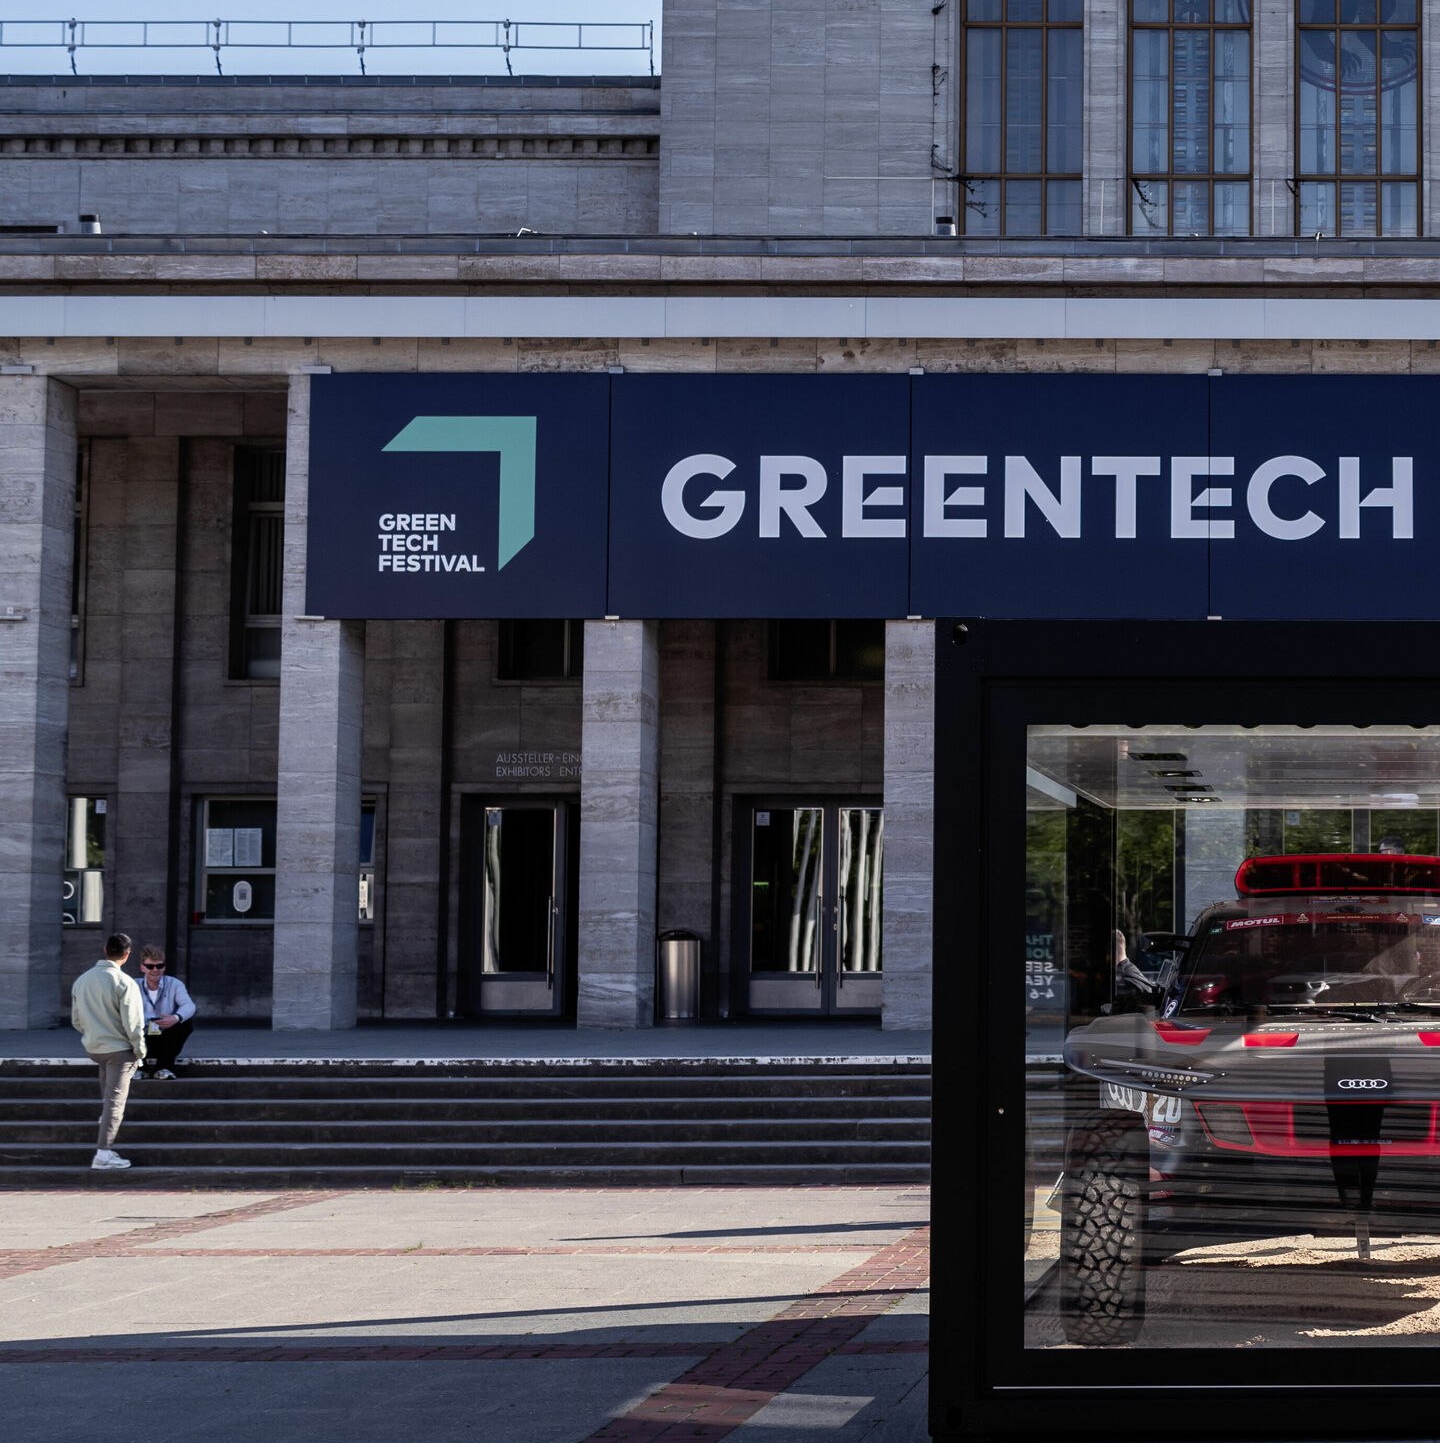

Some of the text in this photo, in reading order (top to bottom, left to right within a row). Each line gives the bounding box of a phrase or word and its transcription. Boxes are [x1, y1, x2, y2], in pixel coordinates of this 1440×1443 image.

[662, 454, 1415, 541] GREENTECH
[378, 513, 456, 531] GREEN
[378, 534, 439, 552] TECH
[378, 555, 486, 572] FESTIVAL
[1230, 917, 1281, 928] MOTUL
